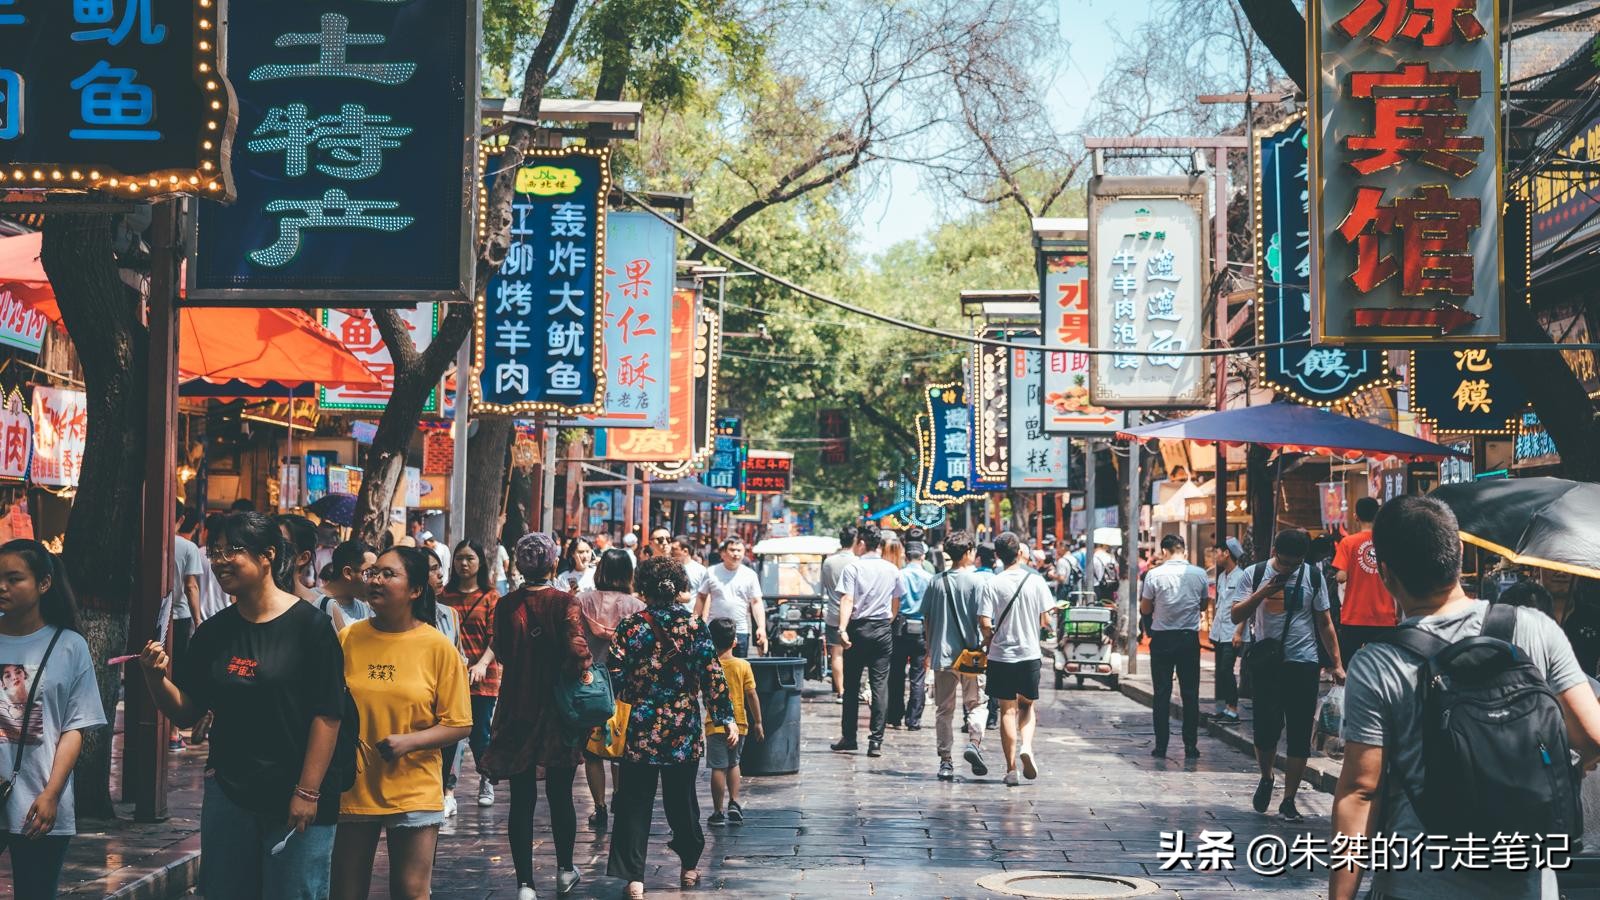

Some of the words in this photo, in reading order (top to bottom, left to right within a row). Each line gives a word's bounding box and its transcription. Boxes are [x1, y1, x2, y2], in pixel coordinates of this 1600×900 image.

[246, 12, 418, 268] 土特产
[545, 201, 587, 396] 轰炸大鱿鱼
[617, 259, 657, 390] 果仁酥
[1112, 249, 1139, 370] 牛羊肉泡馍
[1051, 351, 1089, 374] 自助
[0, 420, 28, 472] 肉
